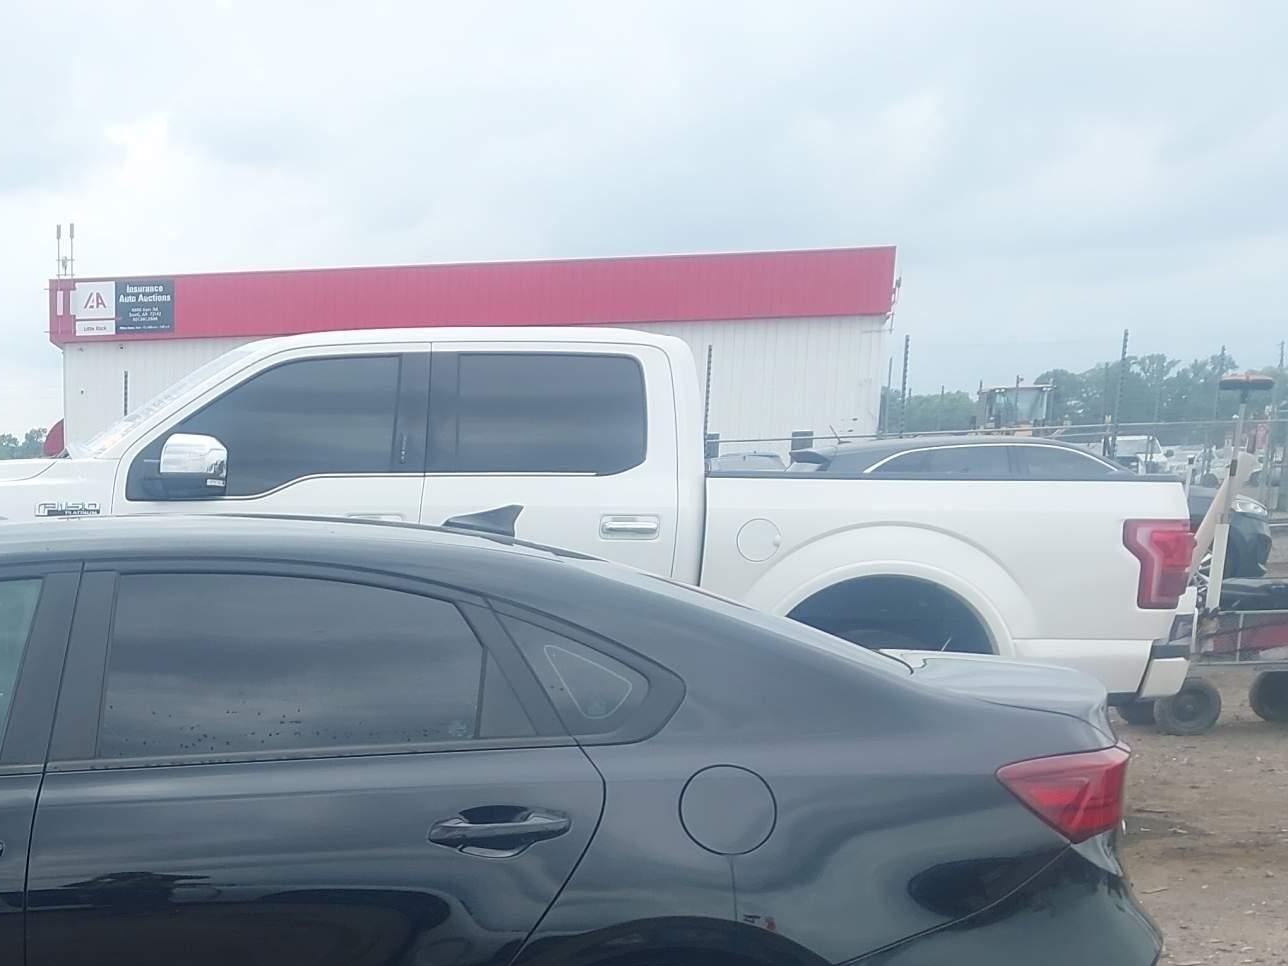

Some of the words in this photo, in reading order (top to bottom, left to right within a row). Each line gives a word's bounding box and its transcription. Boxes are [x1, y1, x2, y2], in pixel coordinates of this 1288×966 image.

[126, 284, 164, 293] Insurance
[119, 294, 137, 303] Auto
[138, 293, 171, 303] Auctions
